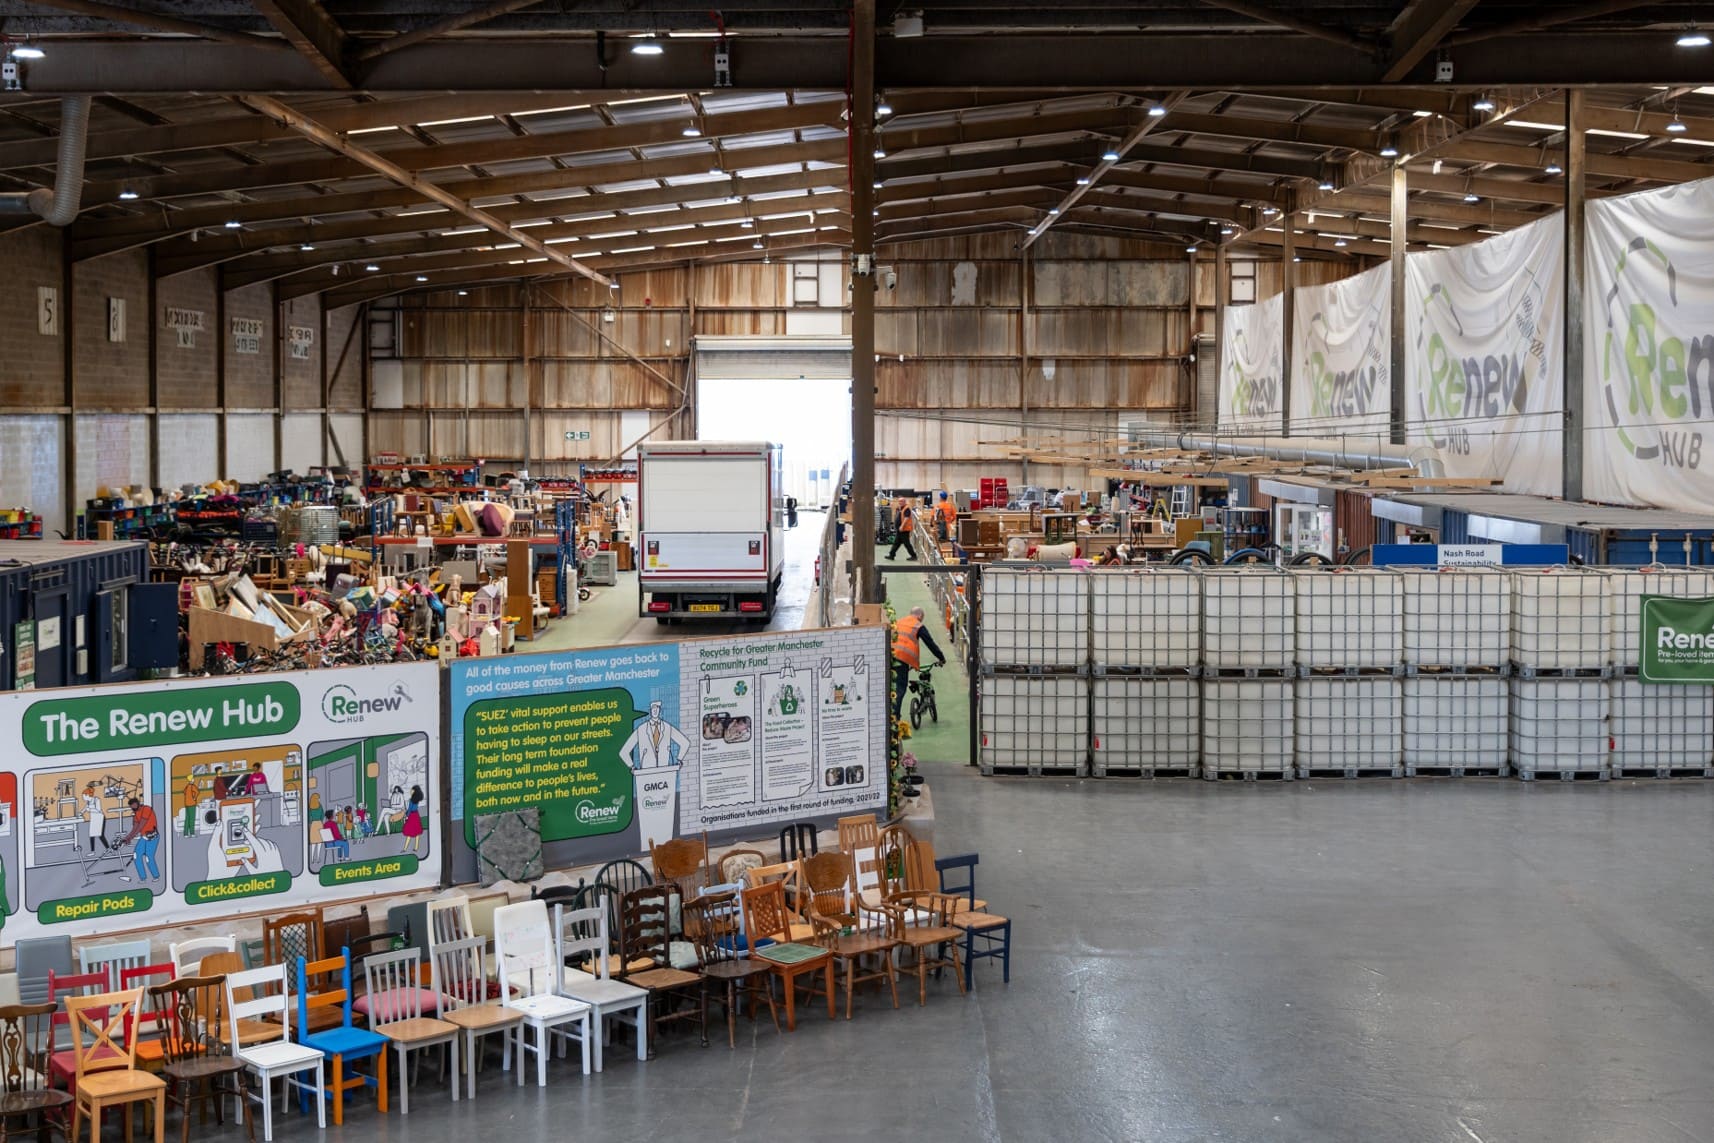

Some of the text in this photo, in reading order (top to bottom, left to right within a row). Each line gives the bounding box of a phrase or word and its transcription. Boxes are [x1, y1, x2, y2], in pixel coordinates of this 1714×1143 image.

[1428, 333, 1526, 419] Renew
[1448, 427, 1470, 456] HUB
[1659, 431, 1703, 470] HUB
[1444, 550, 1485, 558] Nash Road
[700, 640, 824, 658] Recycle for Greater Manchester
[1657, 649, 1697, 658] Pre-loved
[466, 652, 669, 678] All of the money from Renew goes back to
[700, 657, 768, 672] Community Fund
[466, 668, 660, 696] good causes across Greater Manchester
[332, 695, 402, 715] Renew
[511, 706, 530, 719] vital
[532, 704, 568, 718] support
[570, 701, 605, 712] enables
[607, 701, 618, 709] us
[40, 695, 284, 743] The Renew Hub
[346, 713, 365, 724] HUB
[476, 713, 621, 736] to take action to prevent people
[476, 729, 613, 752] having to sleep on our streets.
[476, 744, 599, 765] Their long term foundation
[476, 757, 588, 780] funding will make a real
[476, 780, 522, 795] difference
[525, 778, 535, 788] to
[576, 771, 599, 783] lives,
[644, 781, 669, 792] GMCA
[476, 797, 498, 808] both
[500, 794, 520, 804] now
[523, 791, 541, 803] and
[544, 790, 552, 800] in
[555, 788, 569, 799] the
[645, 798, 668, 808] Renew
[701, 811, 746, 824] Organisations
[747, 808, 770, 817] funded
[778, 803, 789, 812] the
[790, 802, 801, 811] first
[803, 800, 821, 809] round
[822, 799, 829, 807] of
[830, 795, 854, 806] funding,
[856, 792, 880, 802] 2021/22
[580, 804, 621, 819] Renew
[335, 860, 402, 881] Events Area
[198, 877, 276, 899] Click&collect
[56, 896, 135, 918] Repair Pods
